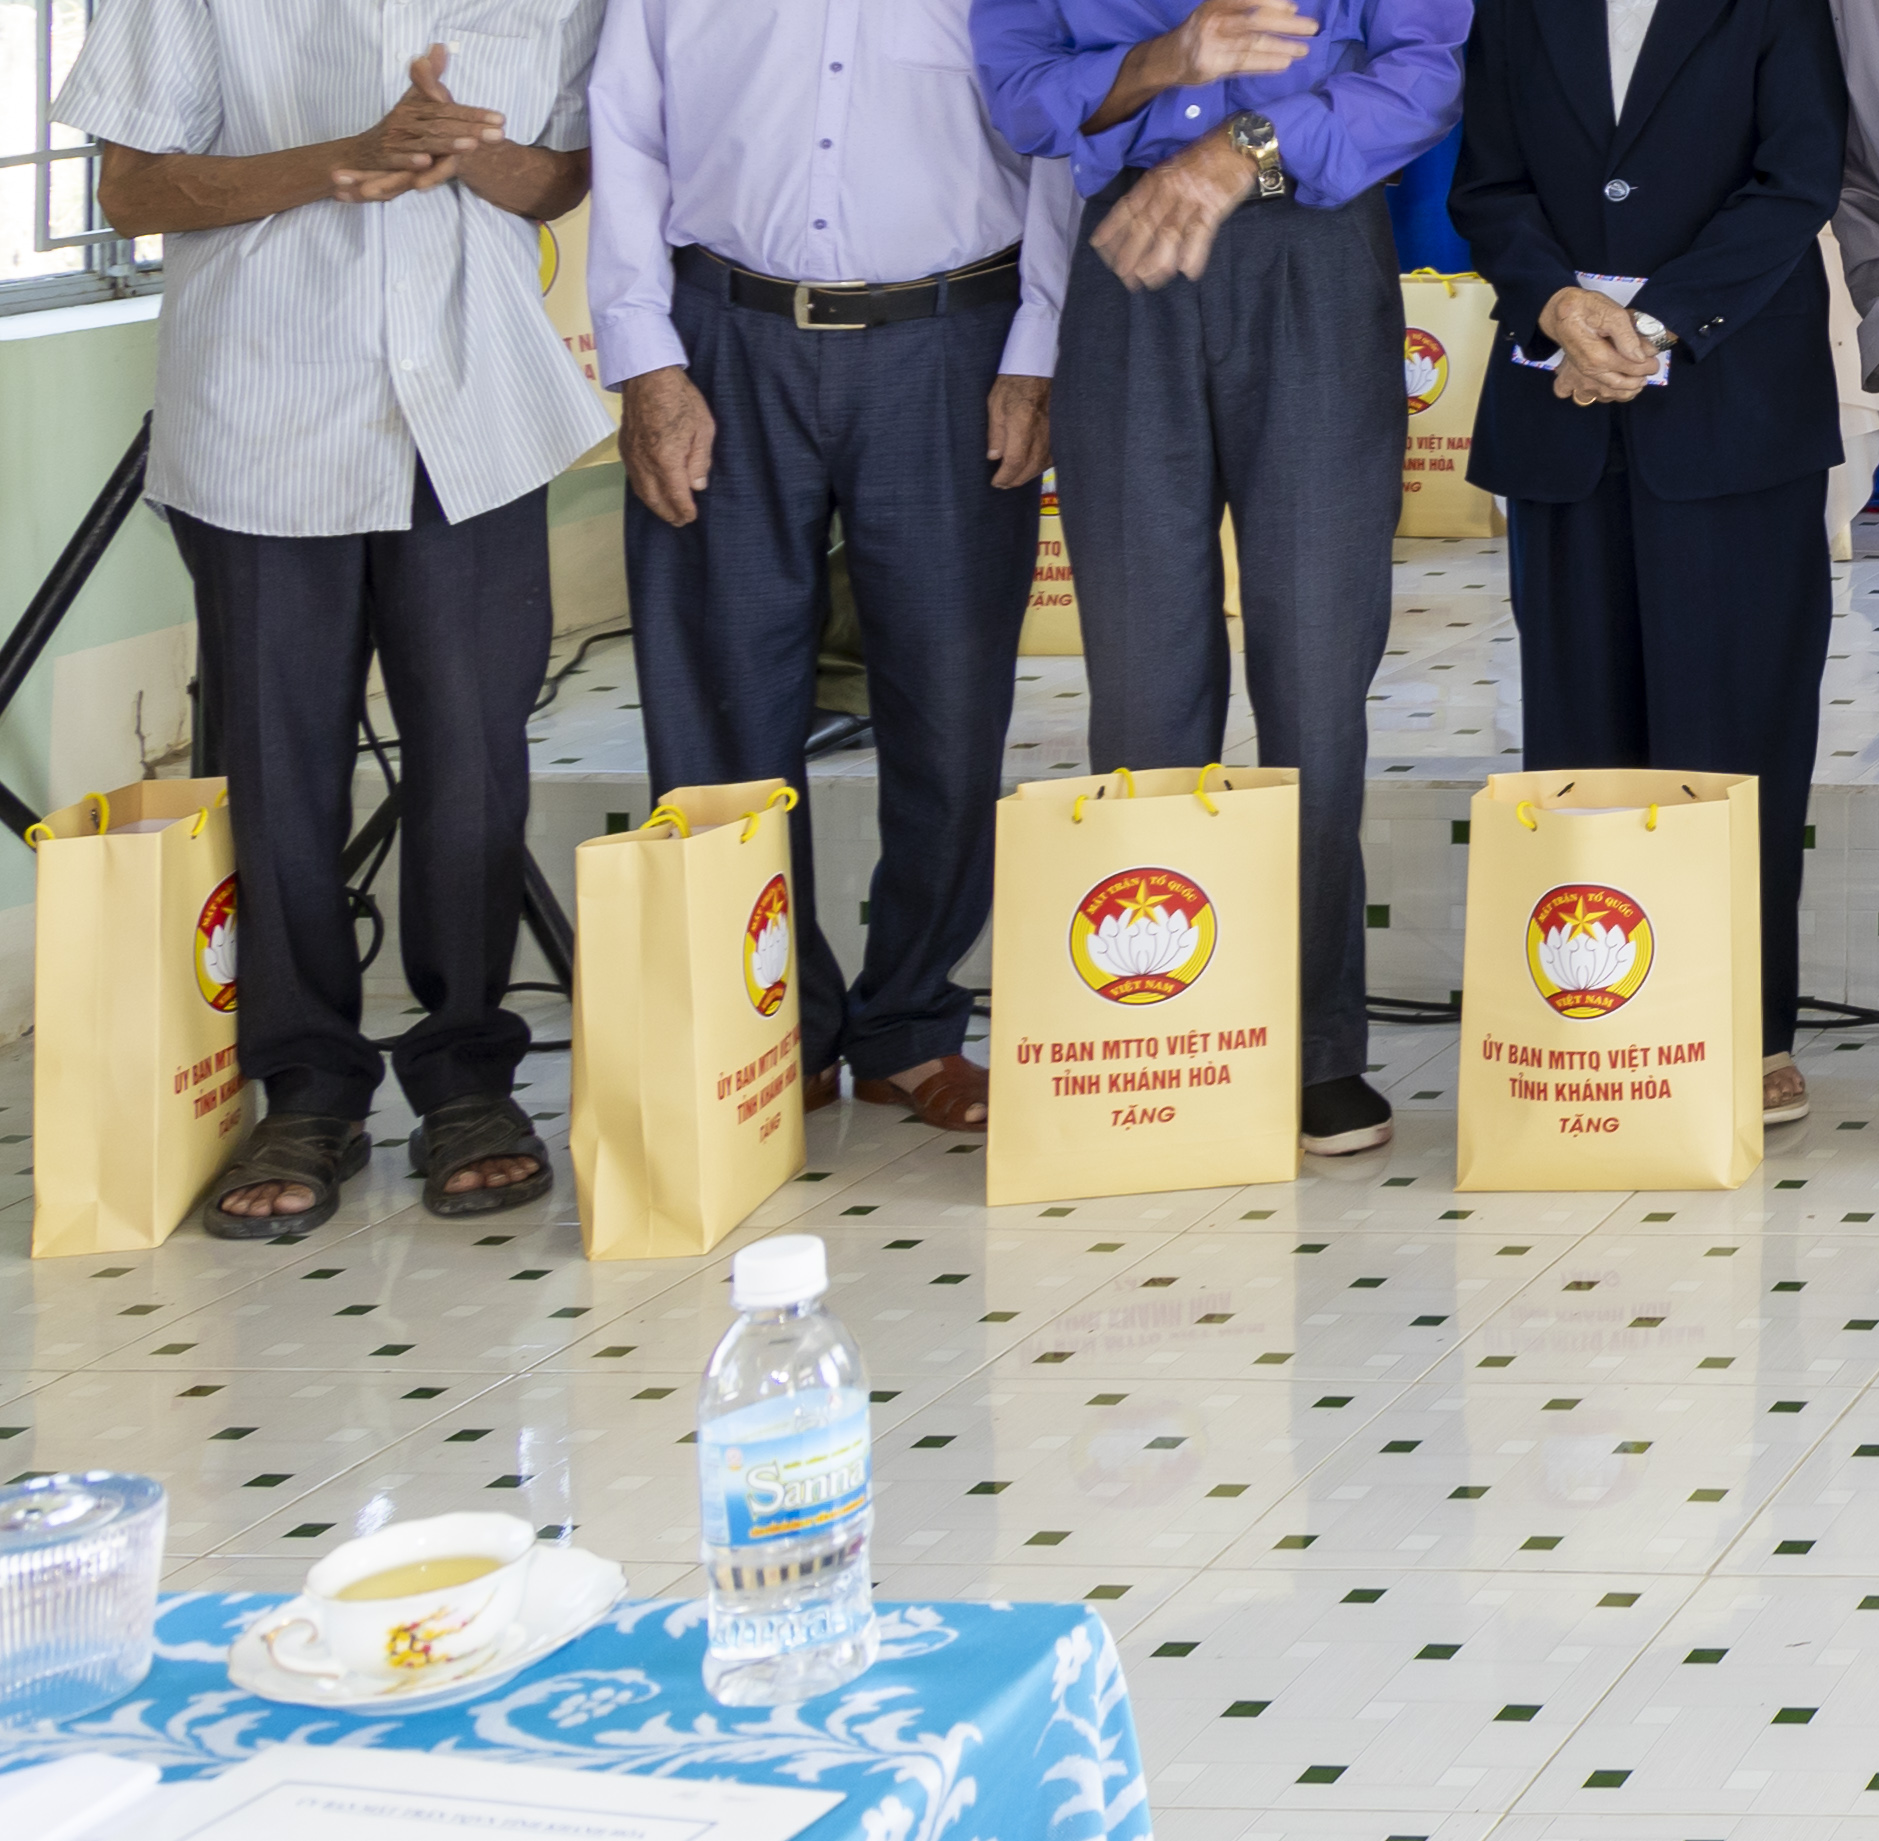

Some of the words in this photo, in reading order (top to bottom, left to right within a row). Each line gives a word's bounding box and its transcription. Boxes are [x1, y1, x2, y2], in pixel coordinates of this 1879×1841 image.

[1417, 434, 1443, 453] VIỆT
[1429, 455, 1454, 471] HÒA
[1018, 1037, 1042, 1064] ỦY
[1051, 1040, 1094, 1063] BAN
[1103, 1037, 1158, 1060] MTTQ
[1167, 1029, 1210, 1059] VIỆT
[1219, 1027, 1266, 1051] NAM
[1483, 1033, 1502, 1061] ỦY
[1508, 1044, 1542, 1067] BAN
[1549, 1049, 1600, 1072] MTTQ
[1608, 1044, 1649, 1073] VIỆT
[1658, 1041, 1704, 1065] NAM
[1053, 1070, 1100, 1097] TỈNH
[1109, 1065, 1180, 1092] KHÁNH
[1189, 1061, 1230, 1088] HÒA
[1510, 1073, 1547, 1101] TỈNH
[1555, 1078, 1623, 1102] KHÁNH
[1631, 1075, 1671, 1100] HÒA
[1113, 1104, 1174, 1130] TẶNG
[1560, 1113, 1618, 1137] TẶNG
[746, 1459, 865, 1521] Sanna
